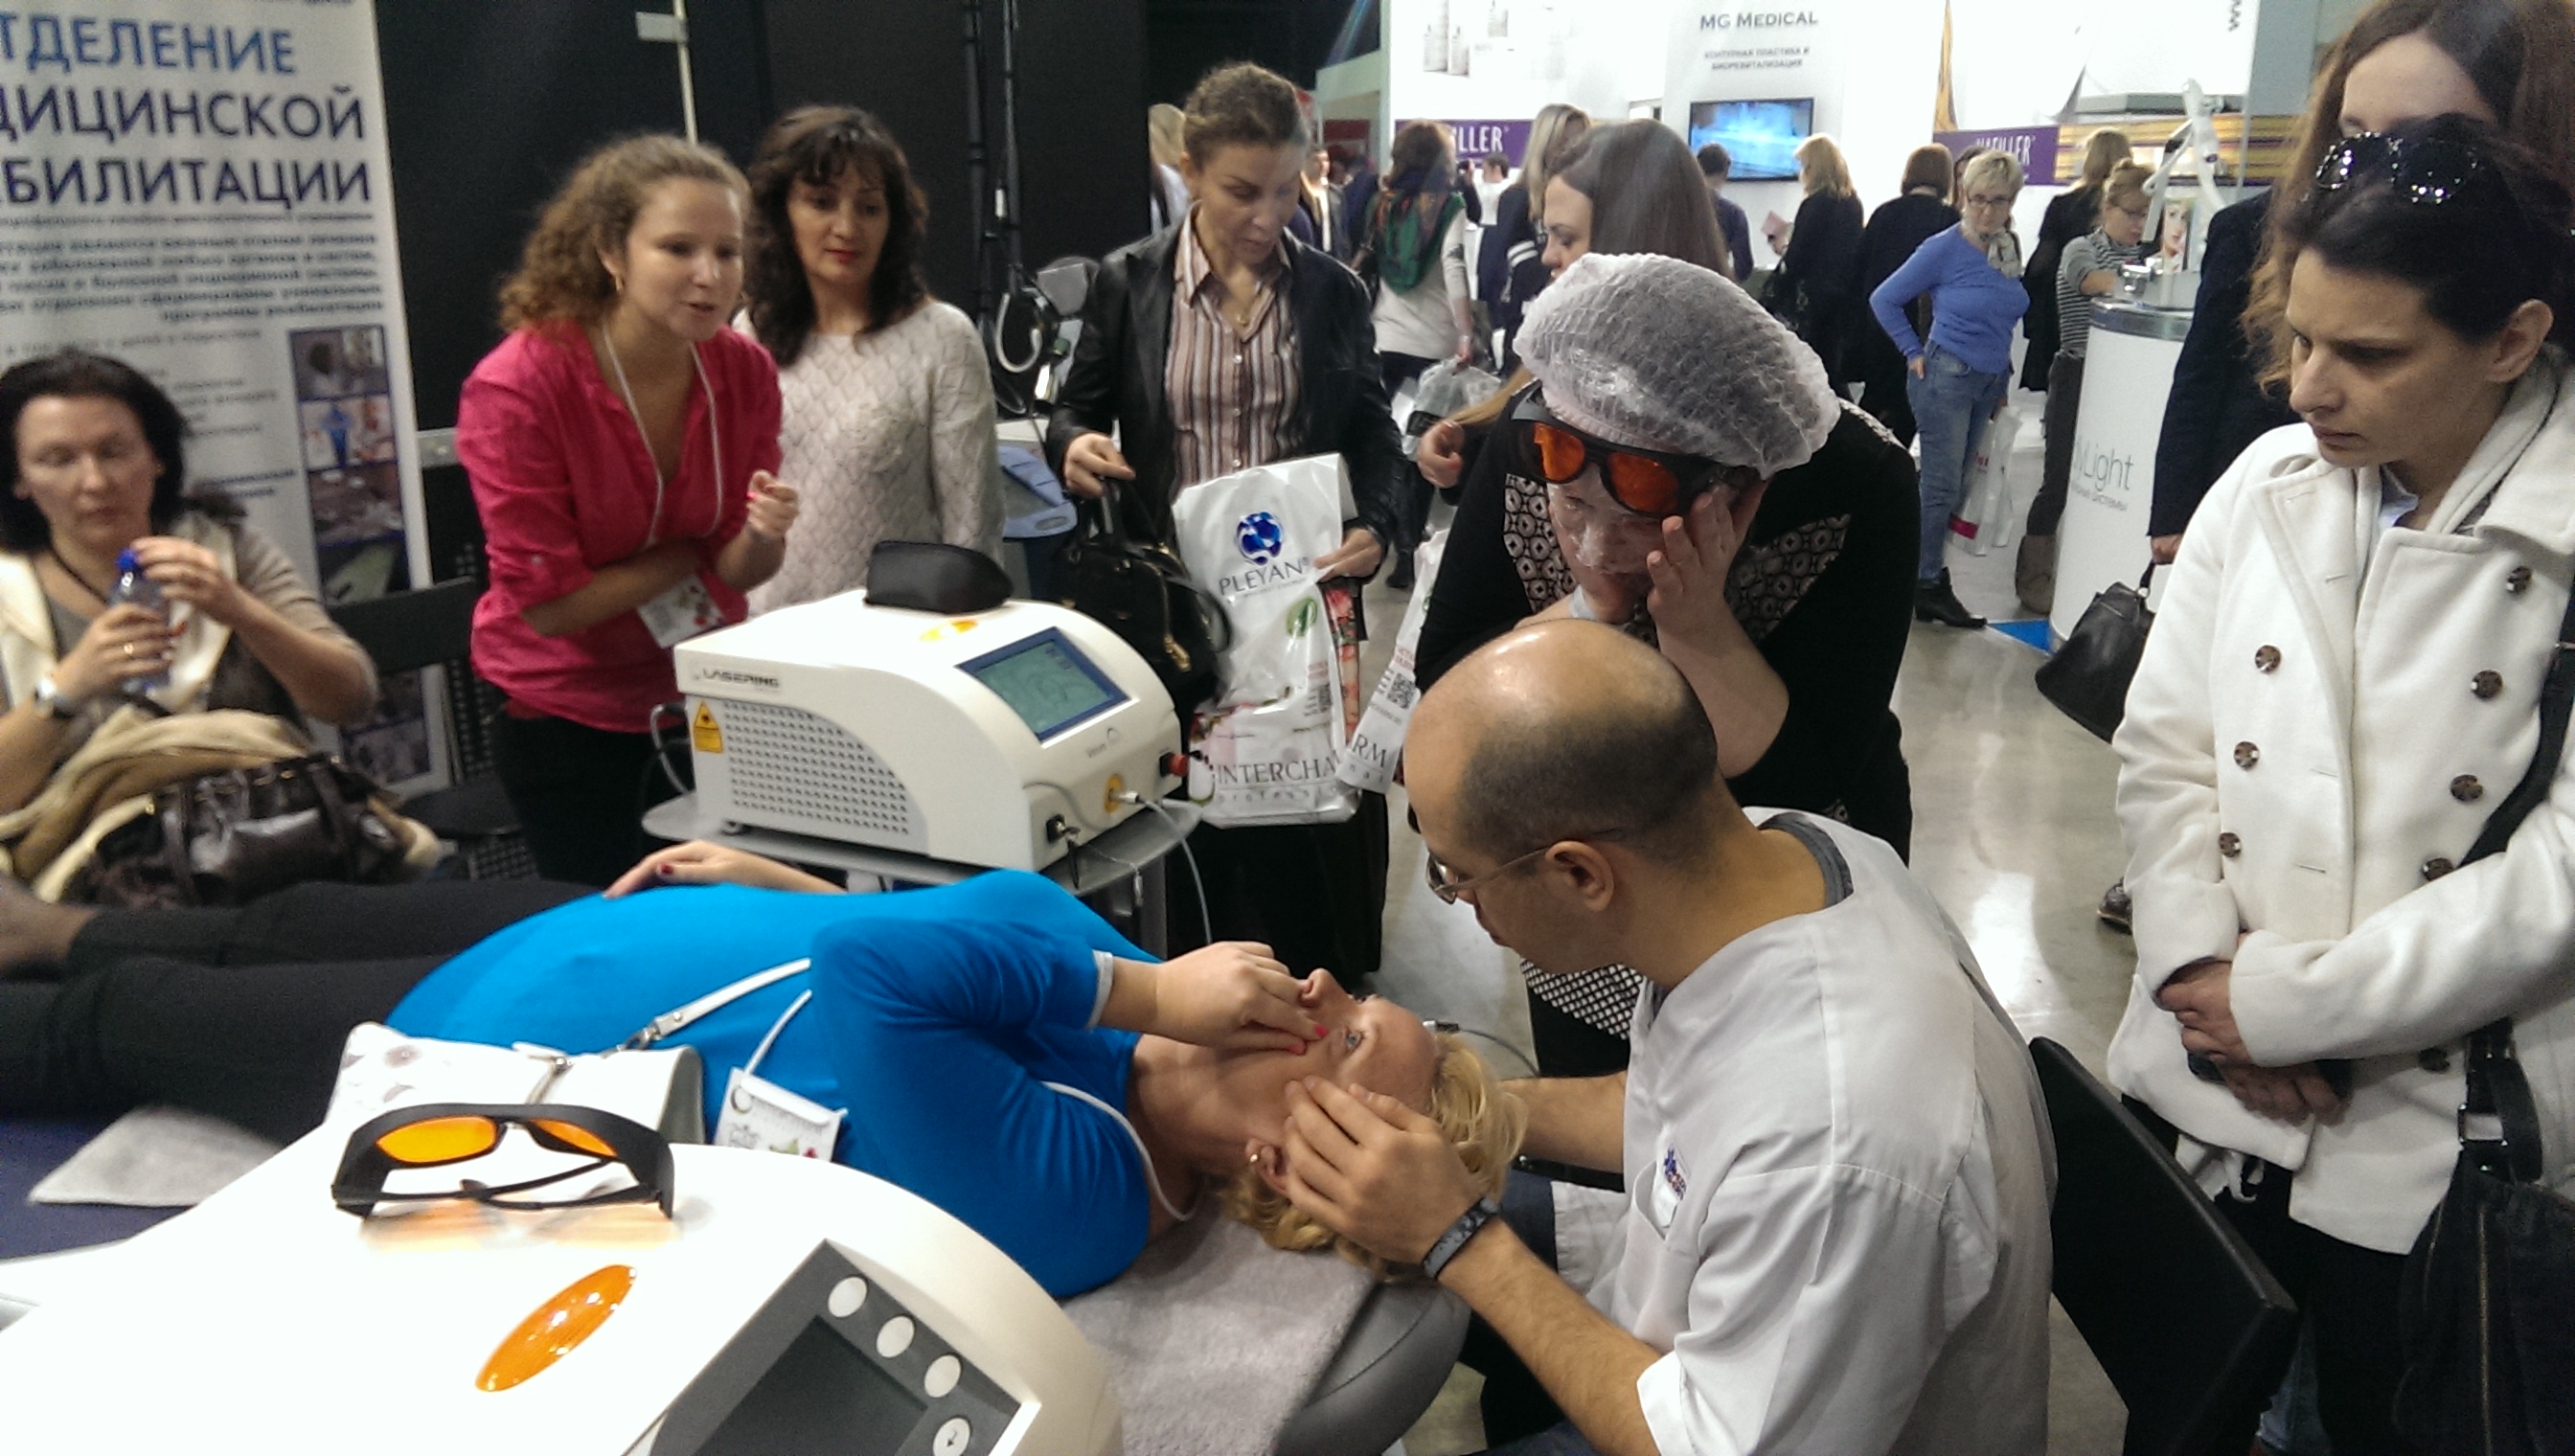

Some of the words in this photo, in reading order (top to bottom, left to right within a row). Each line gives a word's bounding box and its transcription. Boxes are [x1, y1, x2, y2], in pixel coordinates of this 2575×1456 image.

[1699, 13, 1731, 31] MG
[1457, 125, 1503, 153] LLER
[0, 158, 372, 209] БИЛИТАЦИИ
